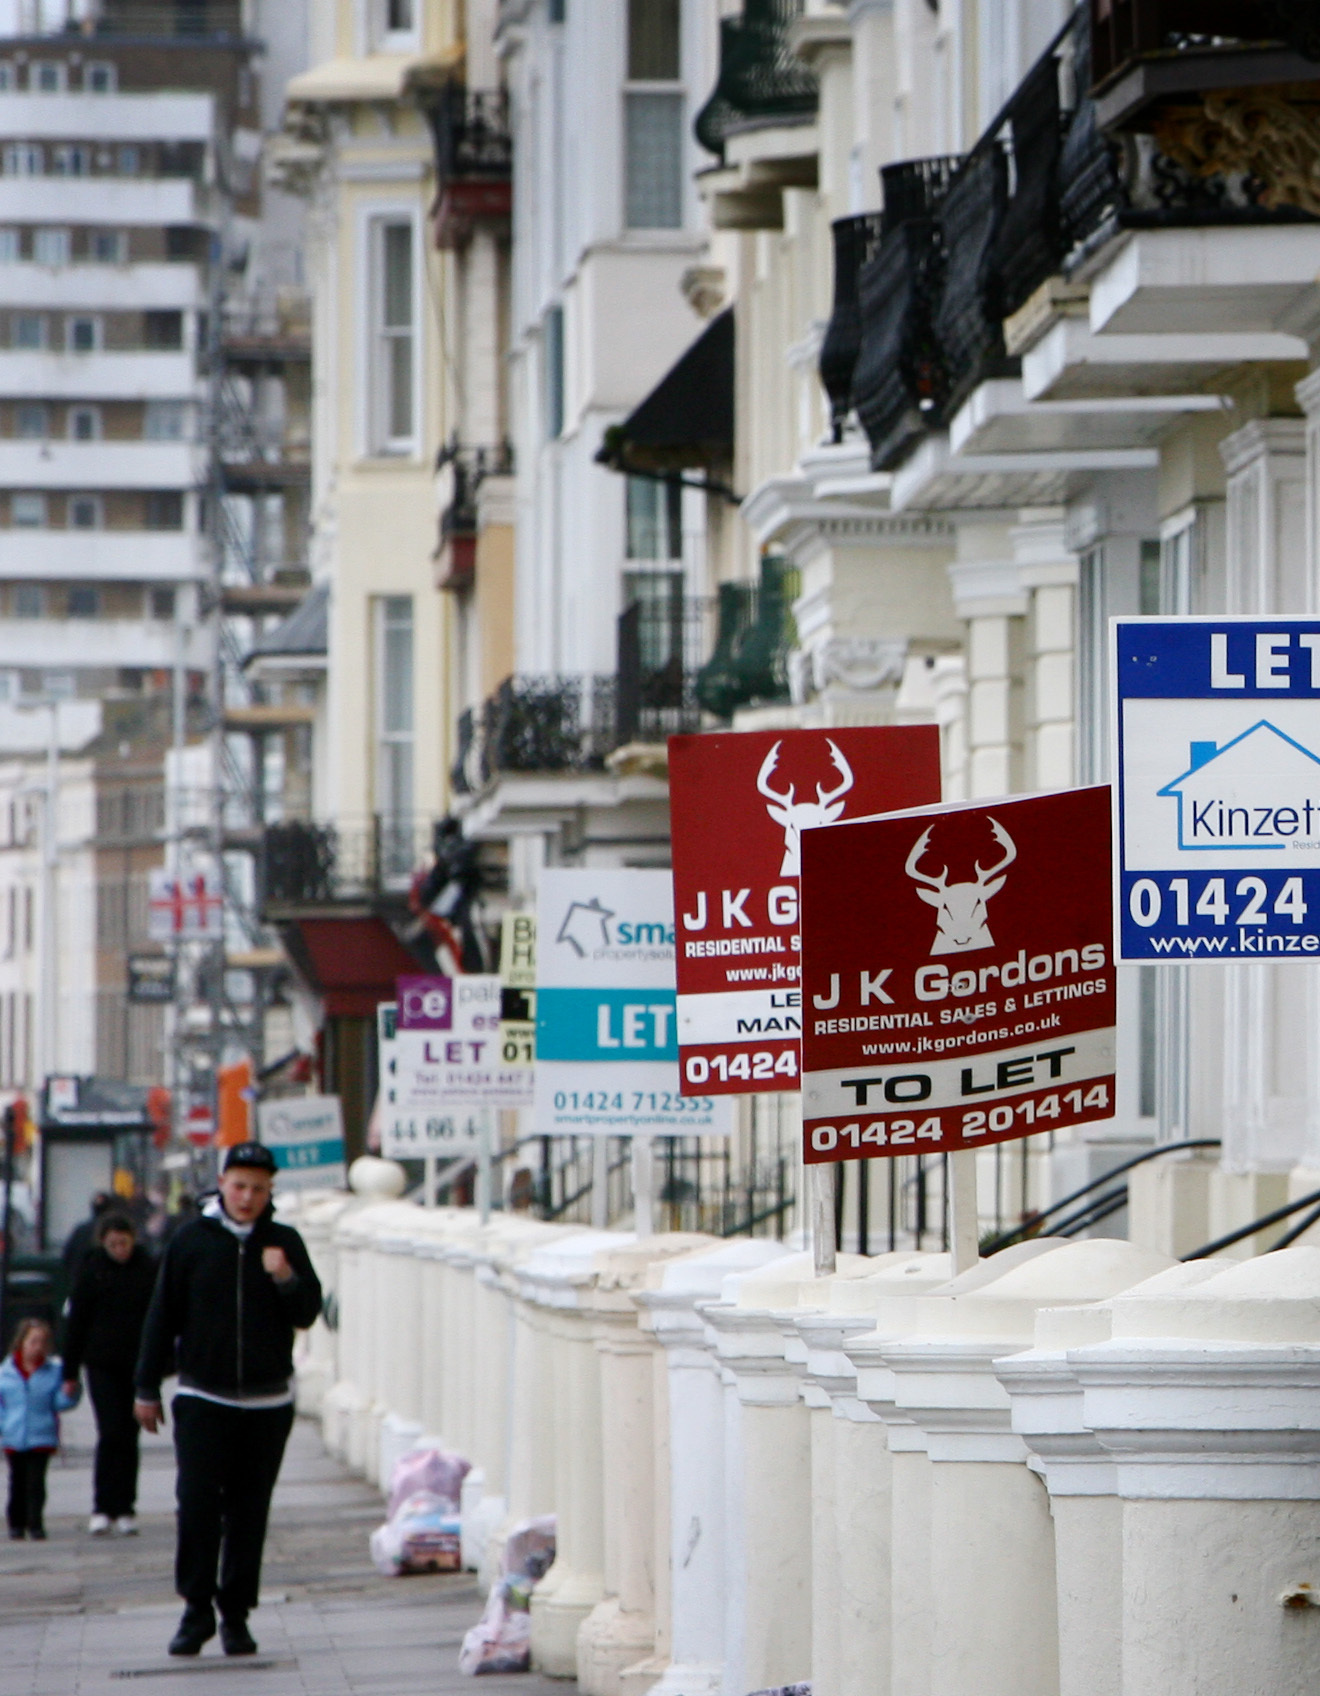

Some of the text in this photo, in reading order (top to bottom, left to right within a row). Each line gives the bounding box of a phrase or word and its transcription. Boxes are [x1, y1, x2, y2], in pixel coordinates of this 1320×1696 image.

[683, 891, 707, 932] J
[722, 888, 753, 929] K
[1129, 877, 1308, 928] 01424
[685, 936, 785, 958] RESIDENTIAL
[813, 943, 1106, 1011] J K Gordons
[597, 1003, 674, 1049] LET
[814, 978, 1107, 1036] RESIDENTIAL SALES & LETTINGS
[423, 1041, 486, 1064] LET
[862, 1012, 1061, 1055] www.jkgordons.co.uk
[685, 1050, 798, 1084] 01424
[840, 1046, 1076, 1107] TO LET
[554, 1091, 623, 1111] 01424
[631, 1091, 714, 1111] 712555
[811, 1083, 1110, 1152] 01424 201414
